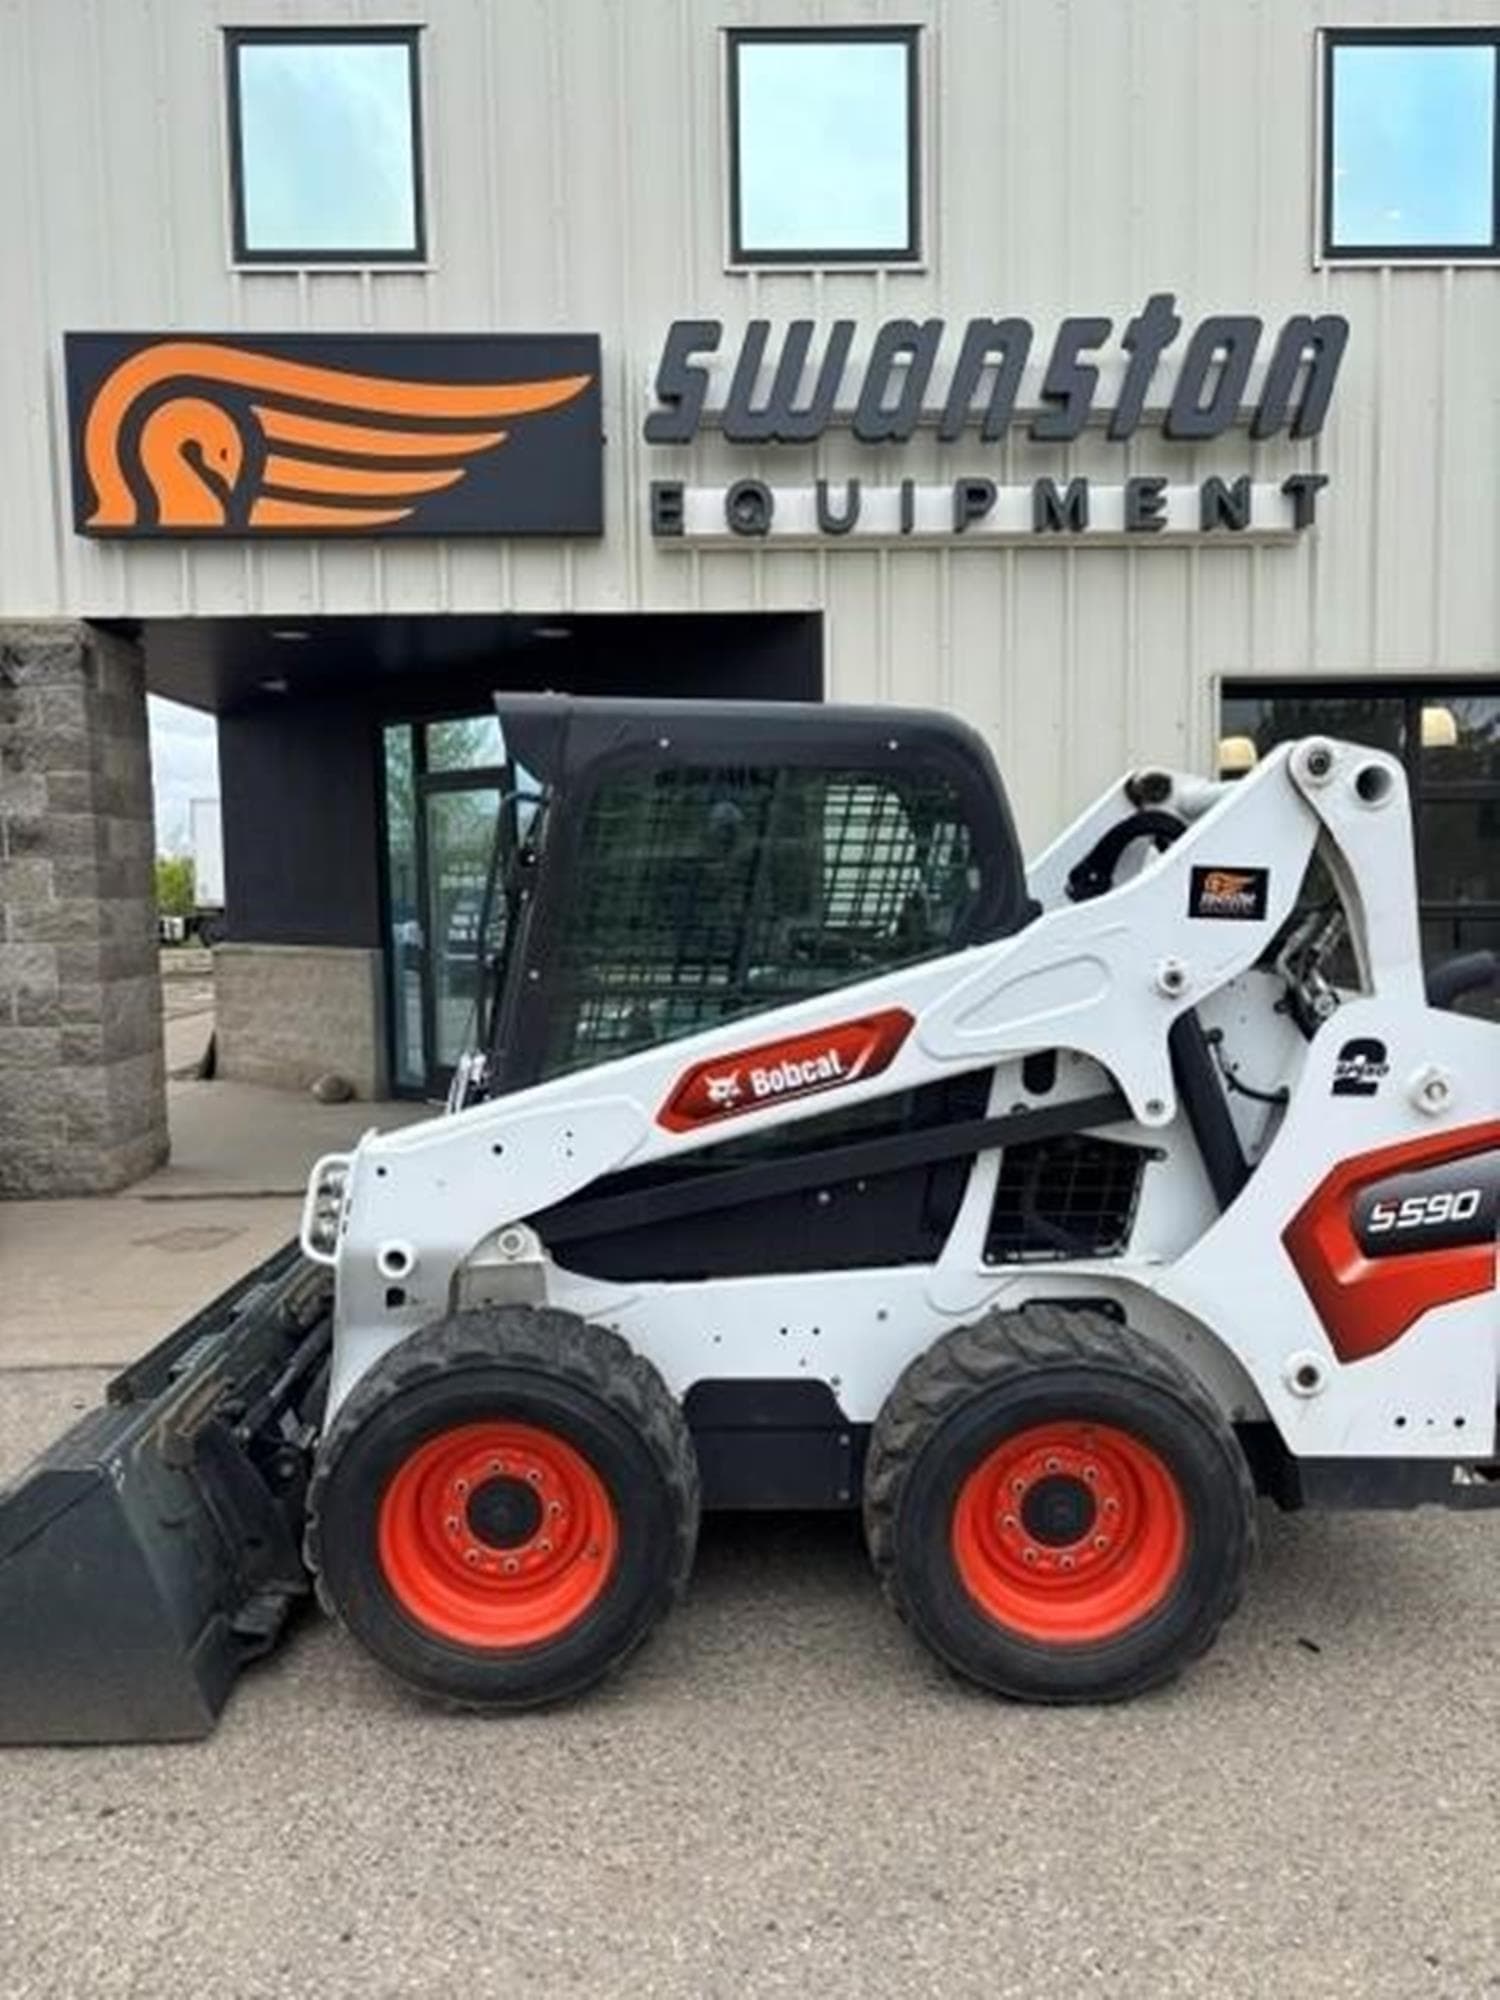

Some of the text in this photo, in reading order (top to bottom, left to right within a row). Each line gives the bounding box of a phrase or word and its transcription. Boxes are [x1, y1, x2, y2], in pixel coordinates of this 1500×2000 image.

[650, 474, 1329, 536] EQUIPMENT
[750, 1049, 841, 1096] Bobcat
[1331, 1038, 1387, 1096] 2
[1367, 1189, 1481, 1232] S590
